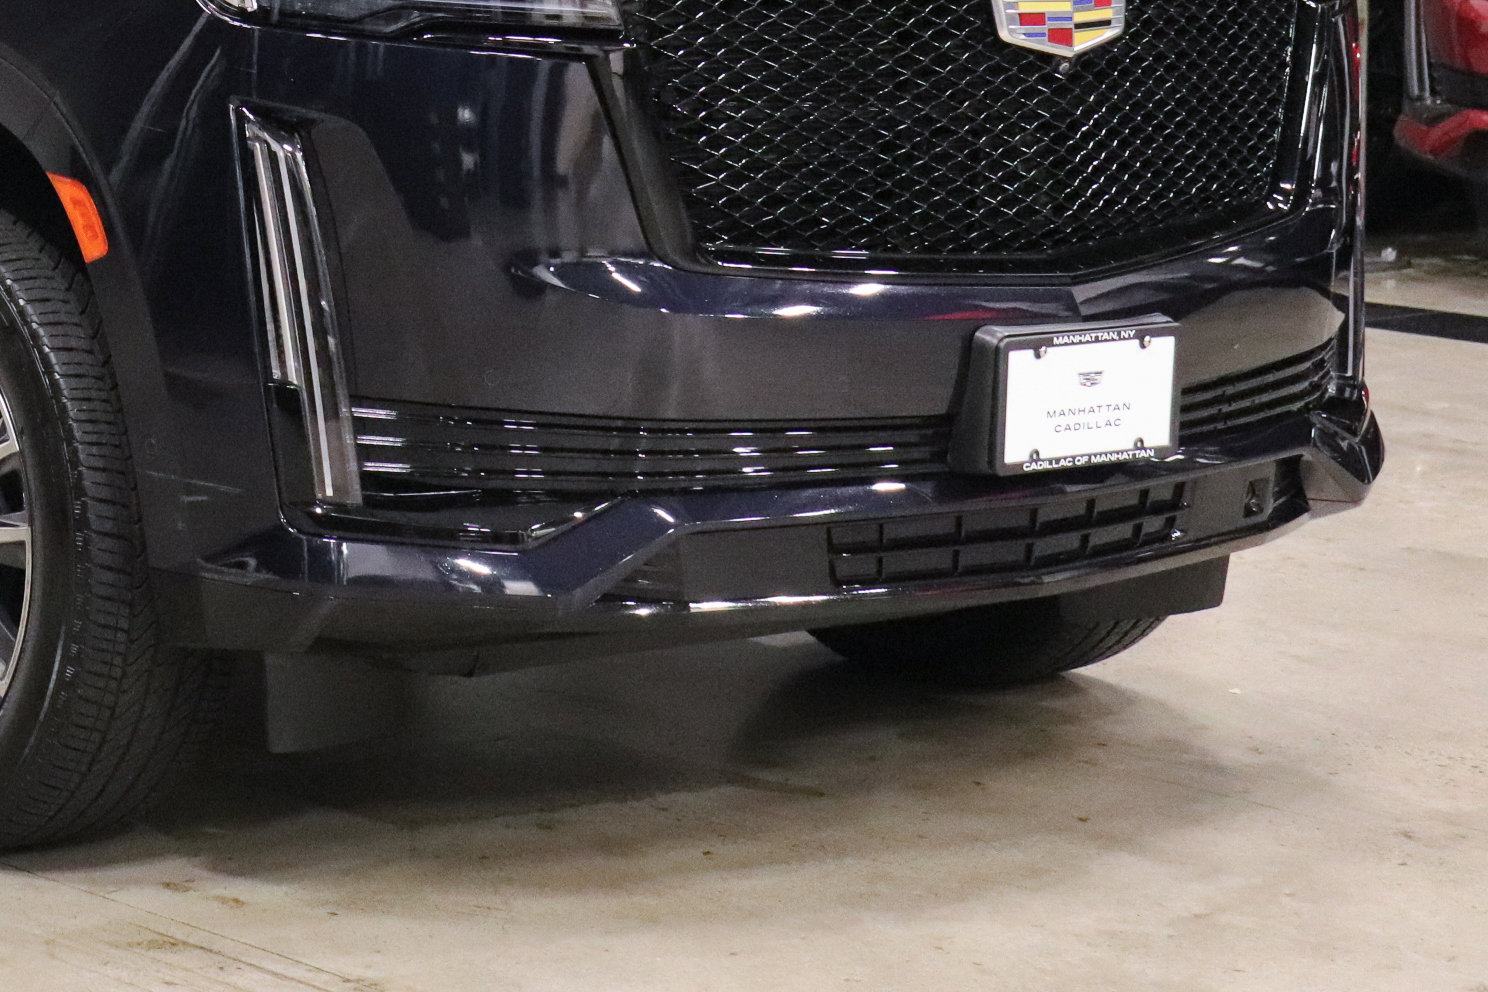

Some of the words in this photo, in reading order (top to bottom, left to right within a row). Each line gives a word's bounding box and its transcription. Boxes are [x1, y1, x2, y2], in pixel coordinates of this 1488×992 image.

[1053, 331, 1119, 345] MANHATTAN,
[1120, 329, 1136, 339] NY
[1046, 402, 1131, 419] MANHATTAN
[1054, 418, 1121, 433] CADILLAC
[1022, 457, 1073, 472] CADILLAC
[1074, 455, 1089, 465] OF
[1090, 448, 1155, 464] MANHATTAN
